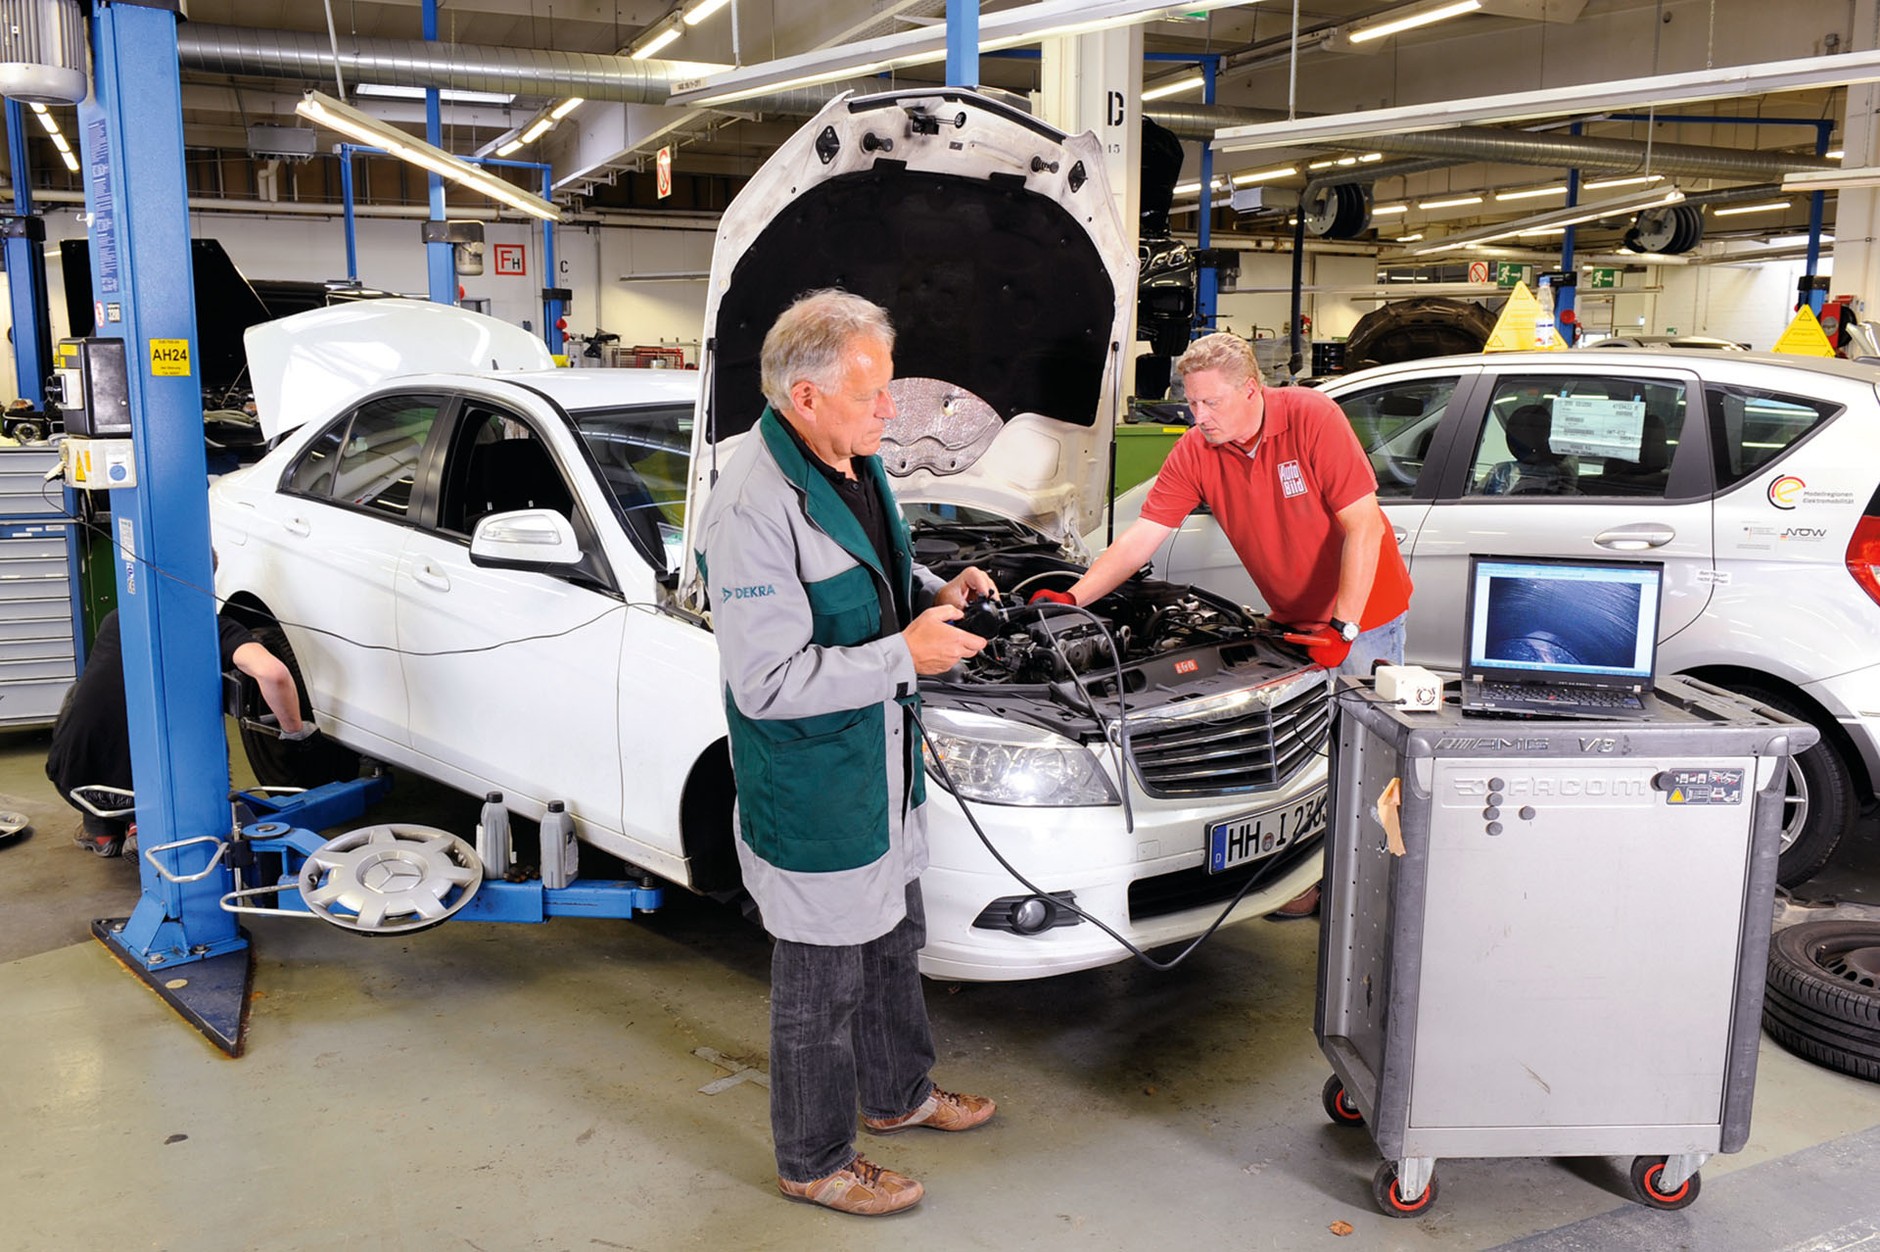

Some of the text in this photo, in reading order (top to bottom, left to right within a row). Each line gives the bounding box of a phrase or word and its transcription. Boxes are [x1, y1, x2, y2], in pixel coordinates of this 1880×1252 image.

[1107, 90, 1124, 126] D
[560, 260, 569, 274] C
[152, 348, 188, 361] AH24
[1284, 478, 1305, 496] Bild
[1781, 528, 1827, 537] NOW
[735, 583, 777, 600] DEKRA
[1473, 737, 1550, 751] AMG
[1508, 776, 1646, 797] FACOM
[1228, 793, 1328, 862] HH I 236
[1215, 852, 1222, 863] D
